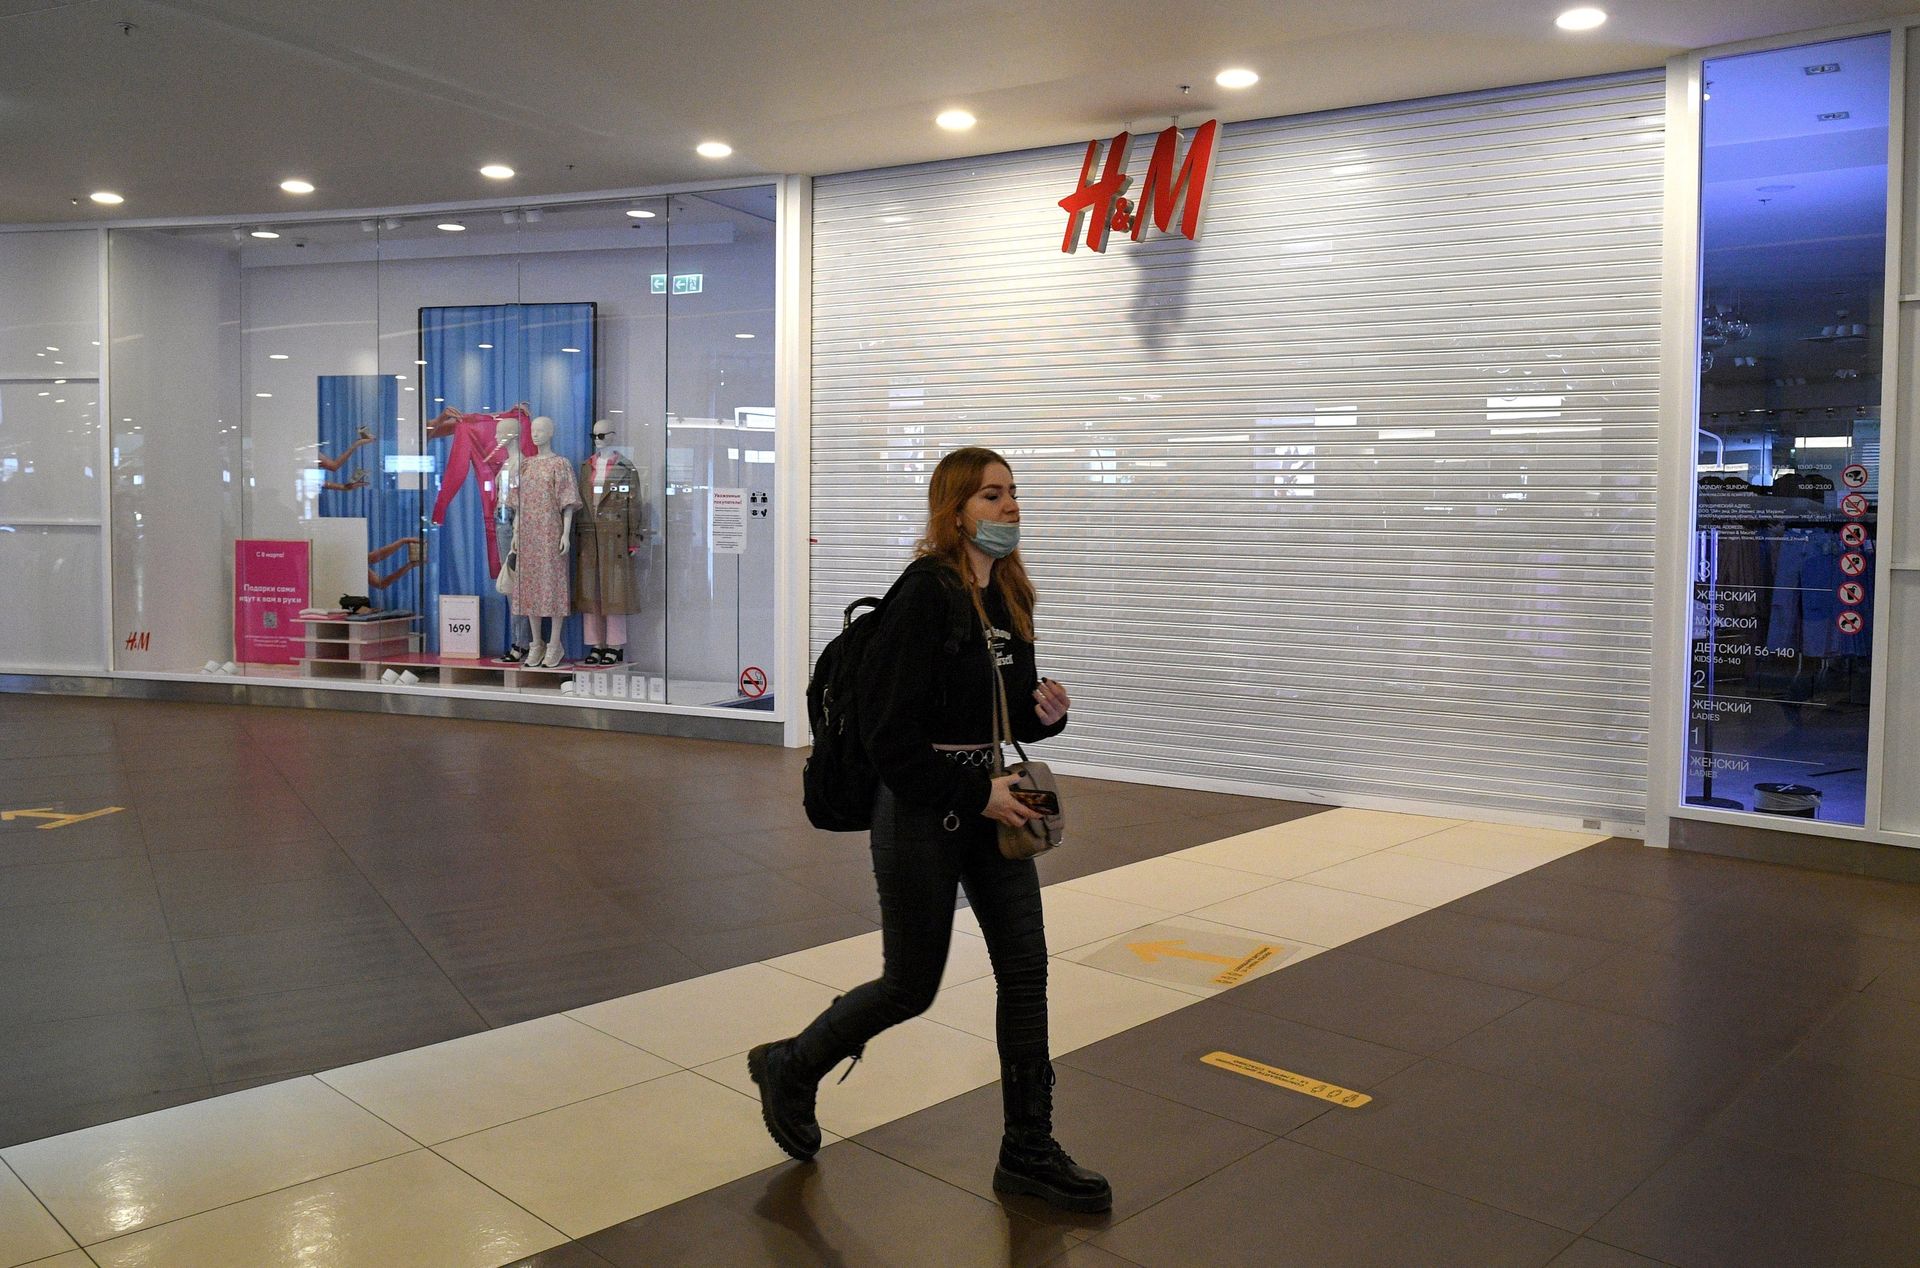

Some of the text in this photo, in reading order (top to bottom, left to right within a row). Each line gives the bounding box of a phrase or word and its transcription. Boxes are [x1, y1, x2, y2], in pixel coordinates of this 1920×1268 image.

[1058, 118, 1220, 254] H&M
[1698, 560, 1711, 579] 3
[243, 584, 275, 593] Подарки
[1696, 590, 1757, 602] ЖЕНСКИЙ
[1695, 603, 1725, 611] LADIES
[448, 623, 471, 633] 1699
[1695, 616, 1758, 629] МУЖСКОЙ
[126, 631, 150, 651] H&M
[1694, 642, 1795, 658] ДЕТСКИЙ 56-140
[1694, 655, 1741, 665] KIDS 56-140
[1693, 669, 1706, 689] 2
[1692, 699, 1752, 714] ЖЕНСКИЙ
[1691, 712, 1720, 721] LADIES
[1691, 727, 1699, 745] 1
[1690, 755, 1750, 772] ЖЕНСКИЙ
[1689, 769, 1718, 779] LADIES
